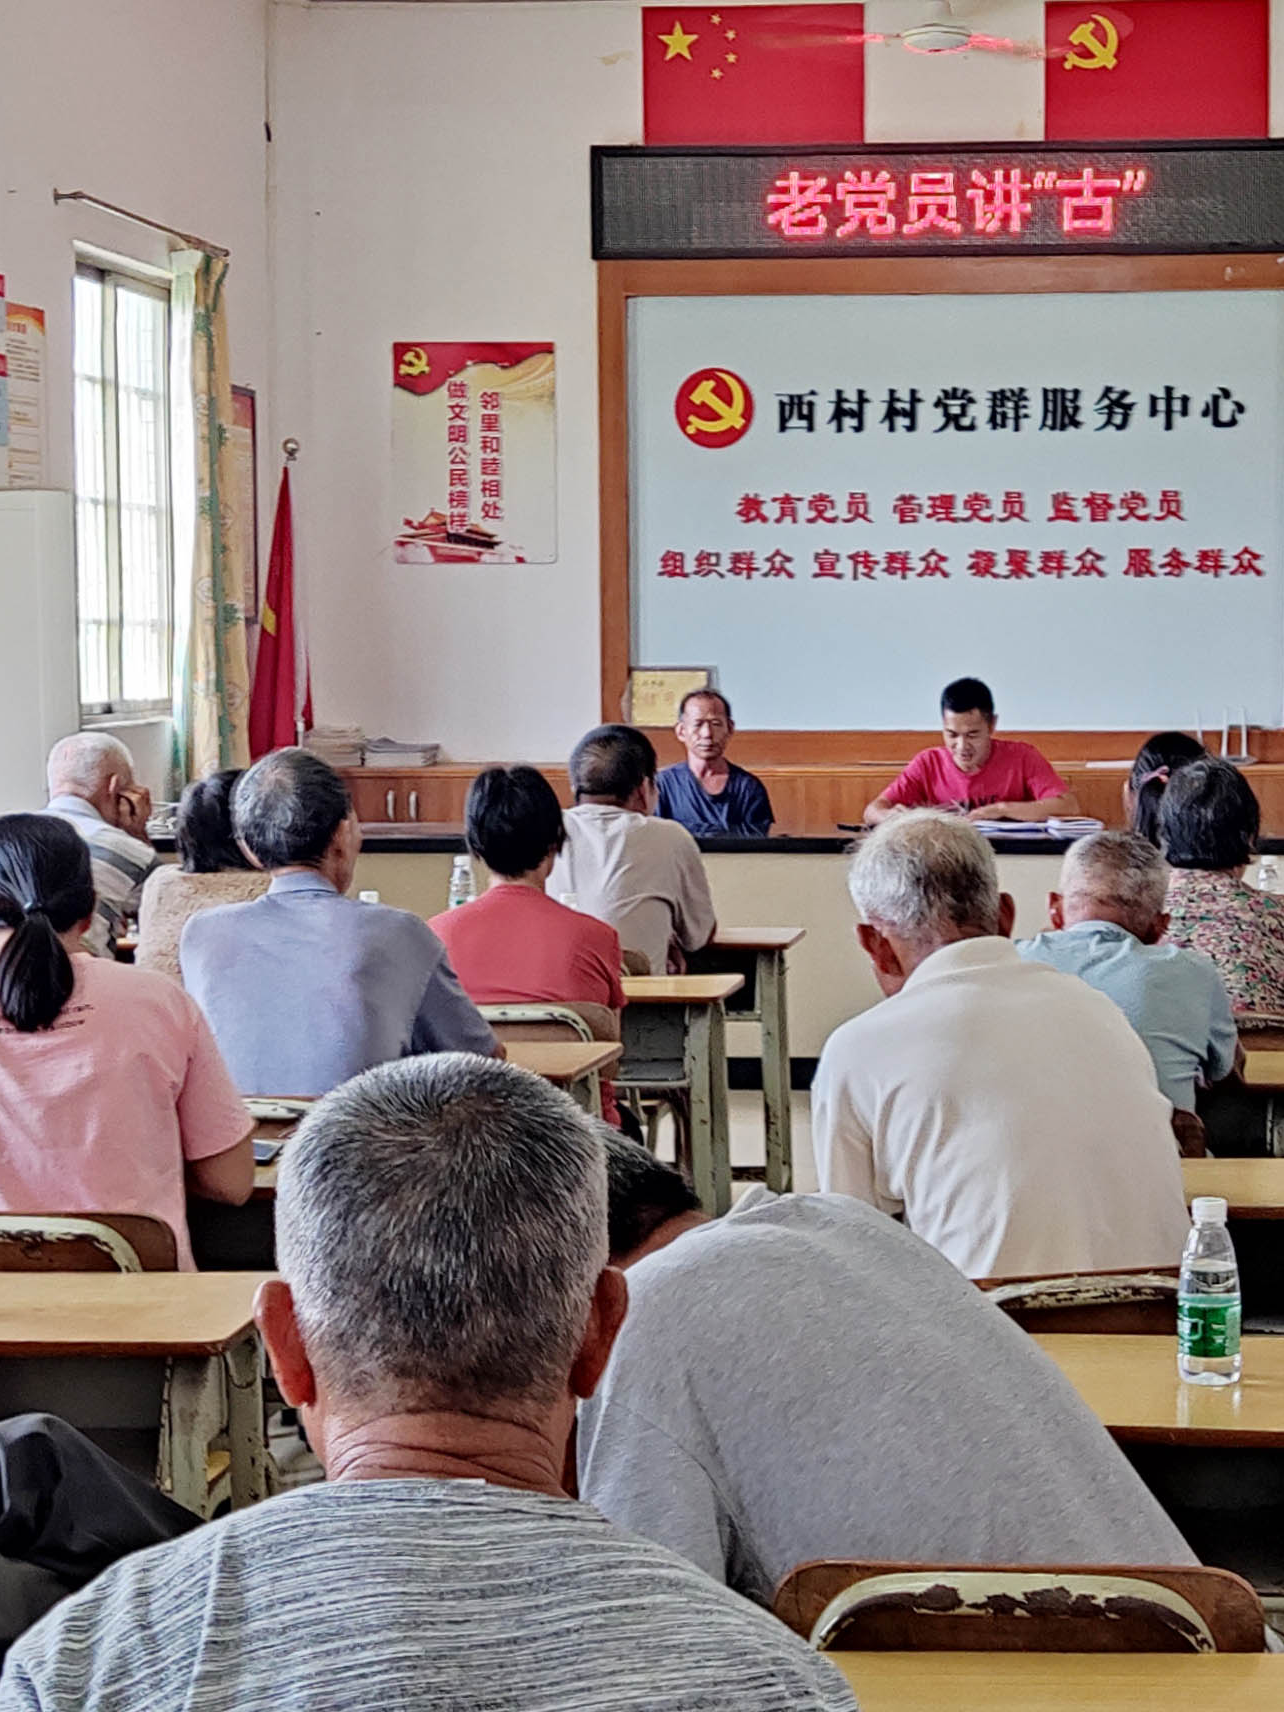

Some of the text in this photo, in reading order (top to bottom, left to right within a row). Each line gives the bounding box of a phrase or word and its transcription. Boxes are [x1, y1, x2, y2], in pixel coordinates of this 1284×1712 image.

[776, 385, 1247, 434] 西村村党群服务中心
[447, 381, 469, 532] 做文明公民榜样
[480, 391, 502, 520] 邻里和睦相处
[735, 490, 1187, 524] 教育党员 管理党员 监督党员
[658, 546, 1266, 579] 组织群众 宣传群众 凝聚群众 服务群众
